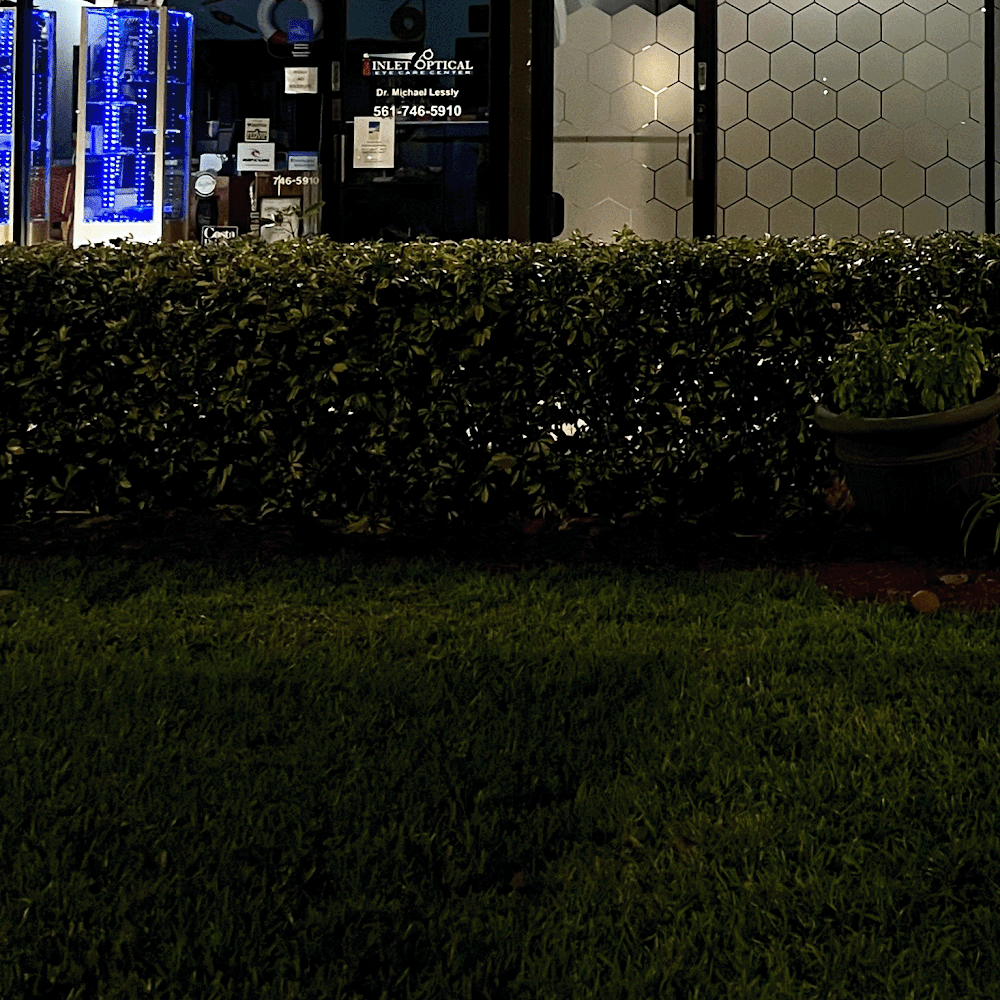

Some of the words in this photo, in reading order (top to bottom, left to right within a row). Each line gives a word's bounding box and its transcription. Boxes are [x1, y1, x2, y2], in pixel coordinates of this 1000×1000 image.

[372, 60, 412, 71] INLET
[414, 59, 474, 71] OPTICAL
[375, 88, 389, 97] Dr.
[391, 88, 427, 97] Michael
[429, 88, 459, 98] Lessly
[373, 105, 462, 117] 561-746-5910
[272, 176, 320, 186] 746-5910
